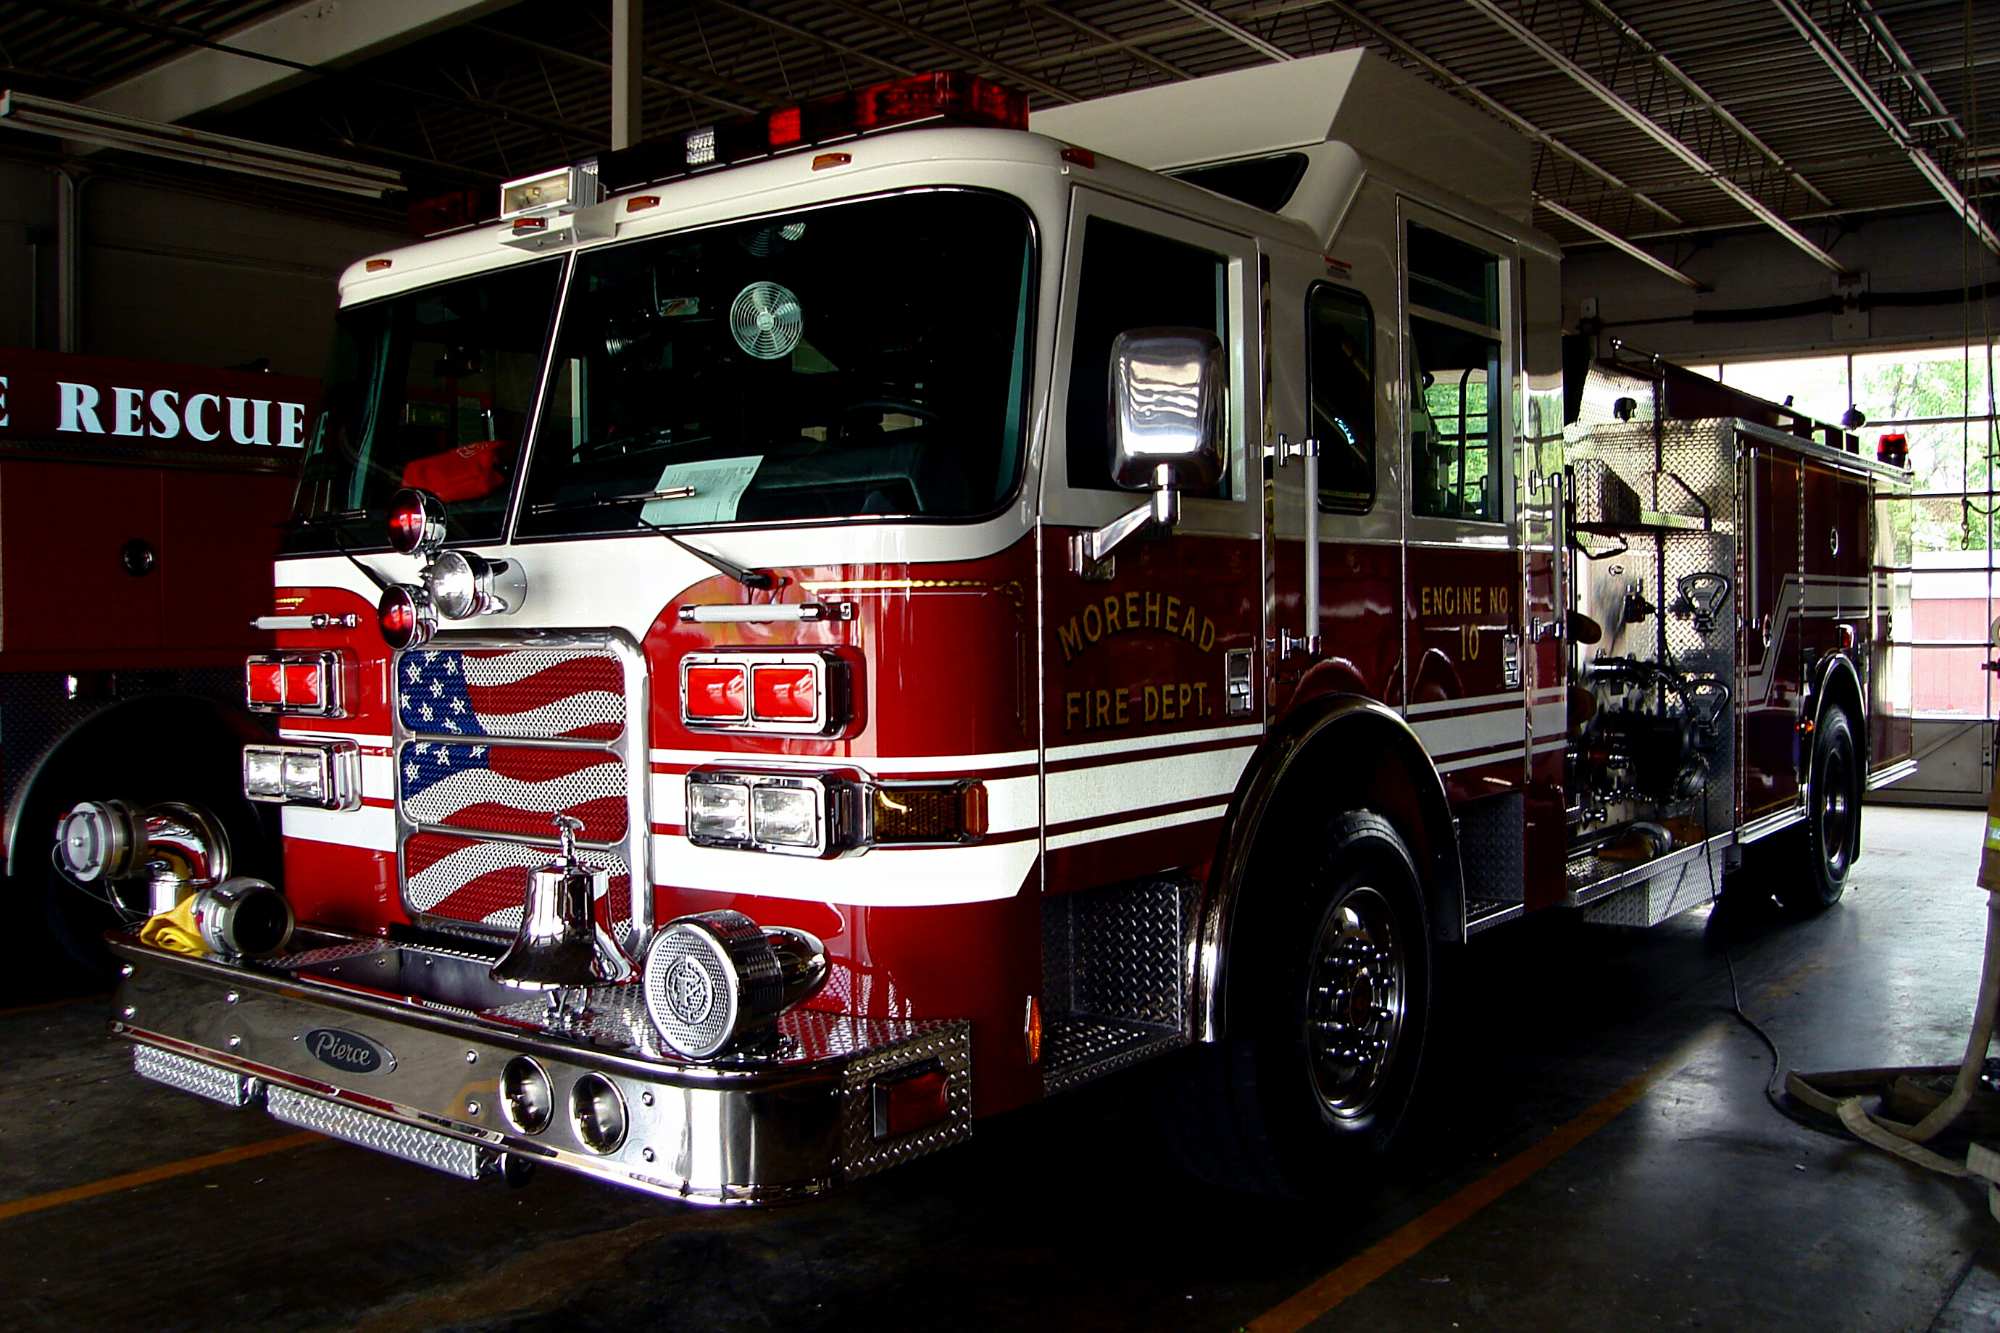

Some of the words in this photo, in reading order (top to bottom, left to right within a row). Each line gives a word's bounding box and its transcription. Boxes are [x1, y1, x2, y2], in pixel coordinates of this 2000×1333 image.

[57, 381, 305, 449] RESCUE
[1421, 586, 1482, 616] ENGINE
[1057, 591, 1216, 662] MOREHEAD
[1460, 623, 1480, 662] 10
[1065, 687, 1130, 730] FIRE
[1143, 681, 1212, 723] DEPT.
[315, 1031, 371, 1066] Pierce
